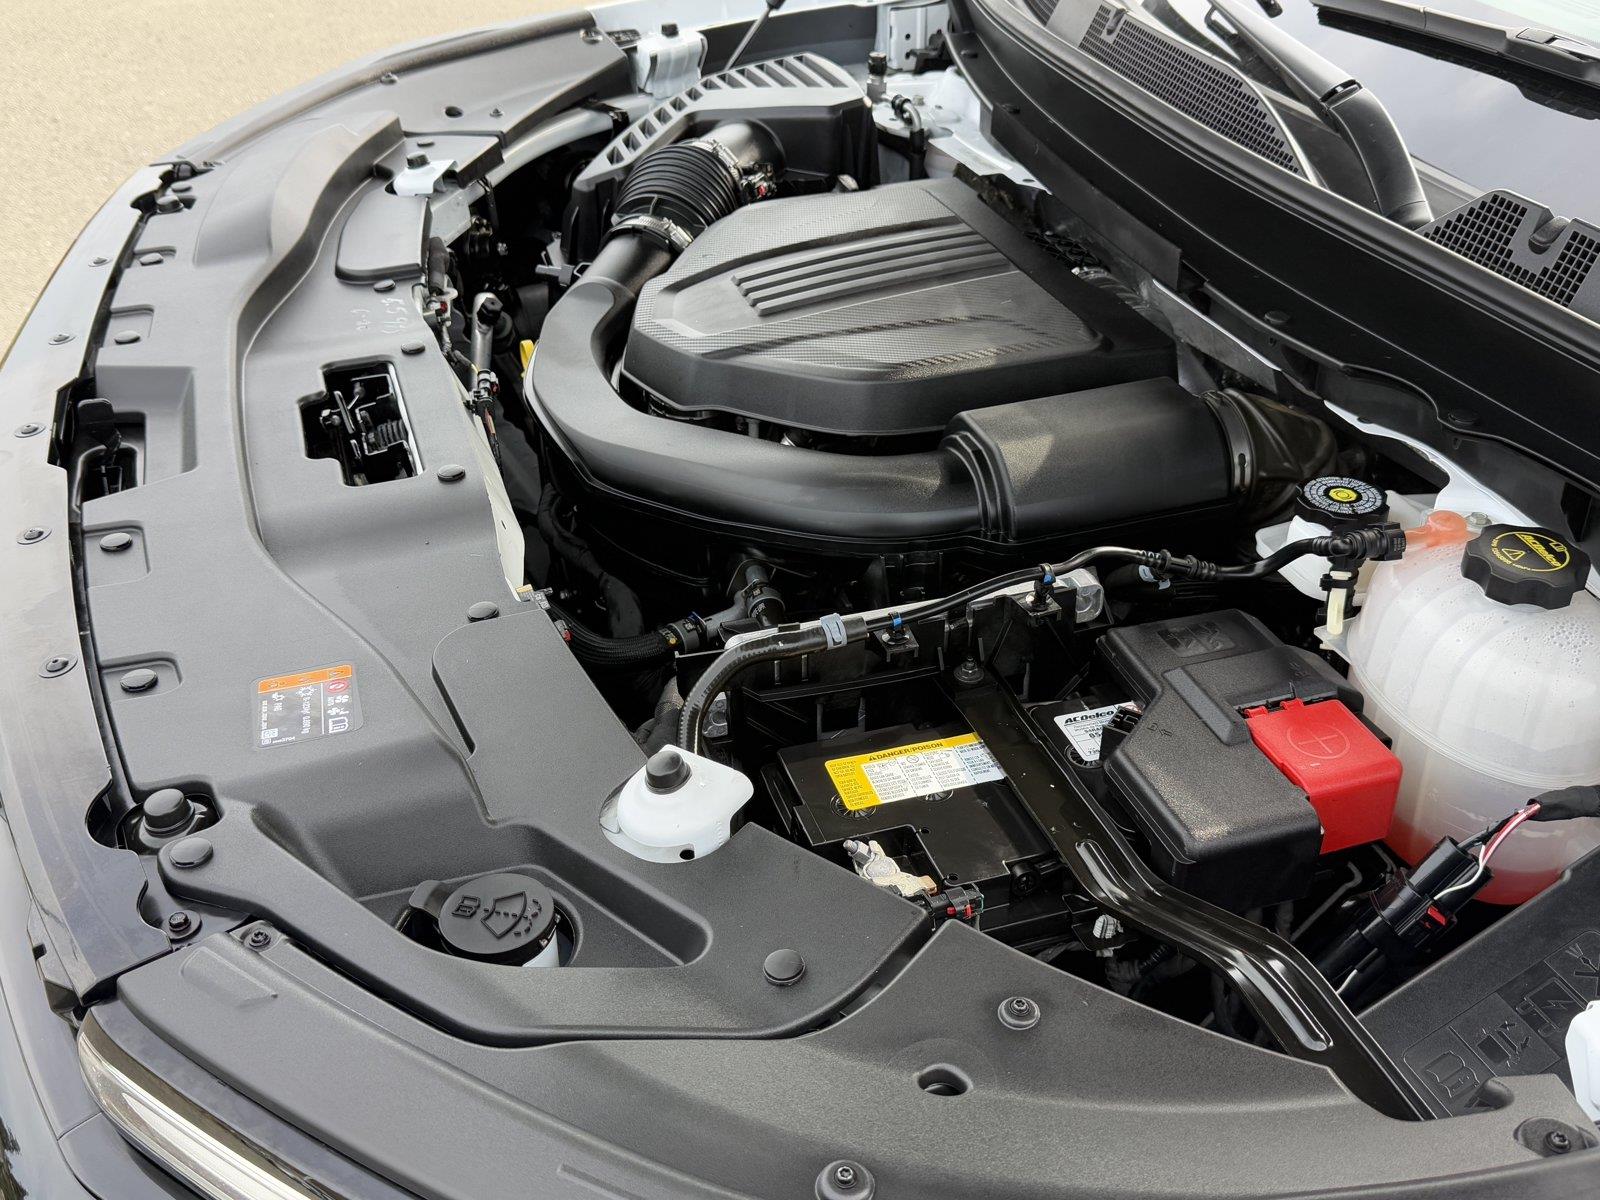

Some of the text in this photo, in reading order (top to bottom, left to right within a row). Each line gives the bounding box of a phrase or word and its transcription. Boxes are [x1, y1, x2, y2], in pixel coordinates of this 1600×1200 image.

[1521, 534, 1562, 567] ACDelco
[1064, 710, 1115, 724] ACDelco
[875, 741, 944, 760] DANGER/POISON
